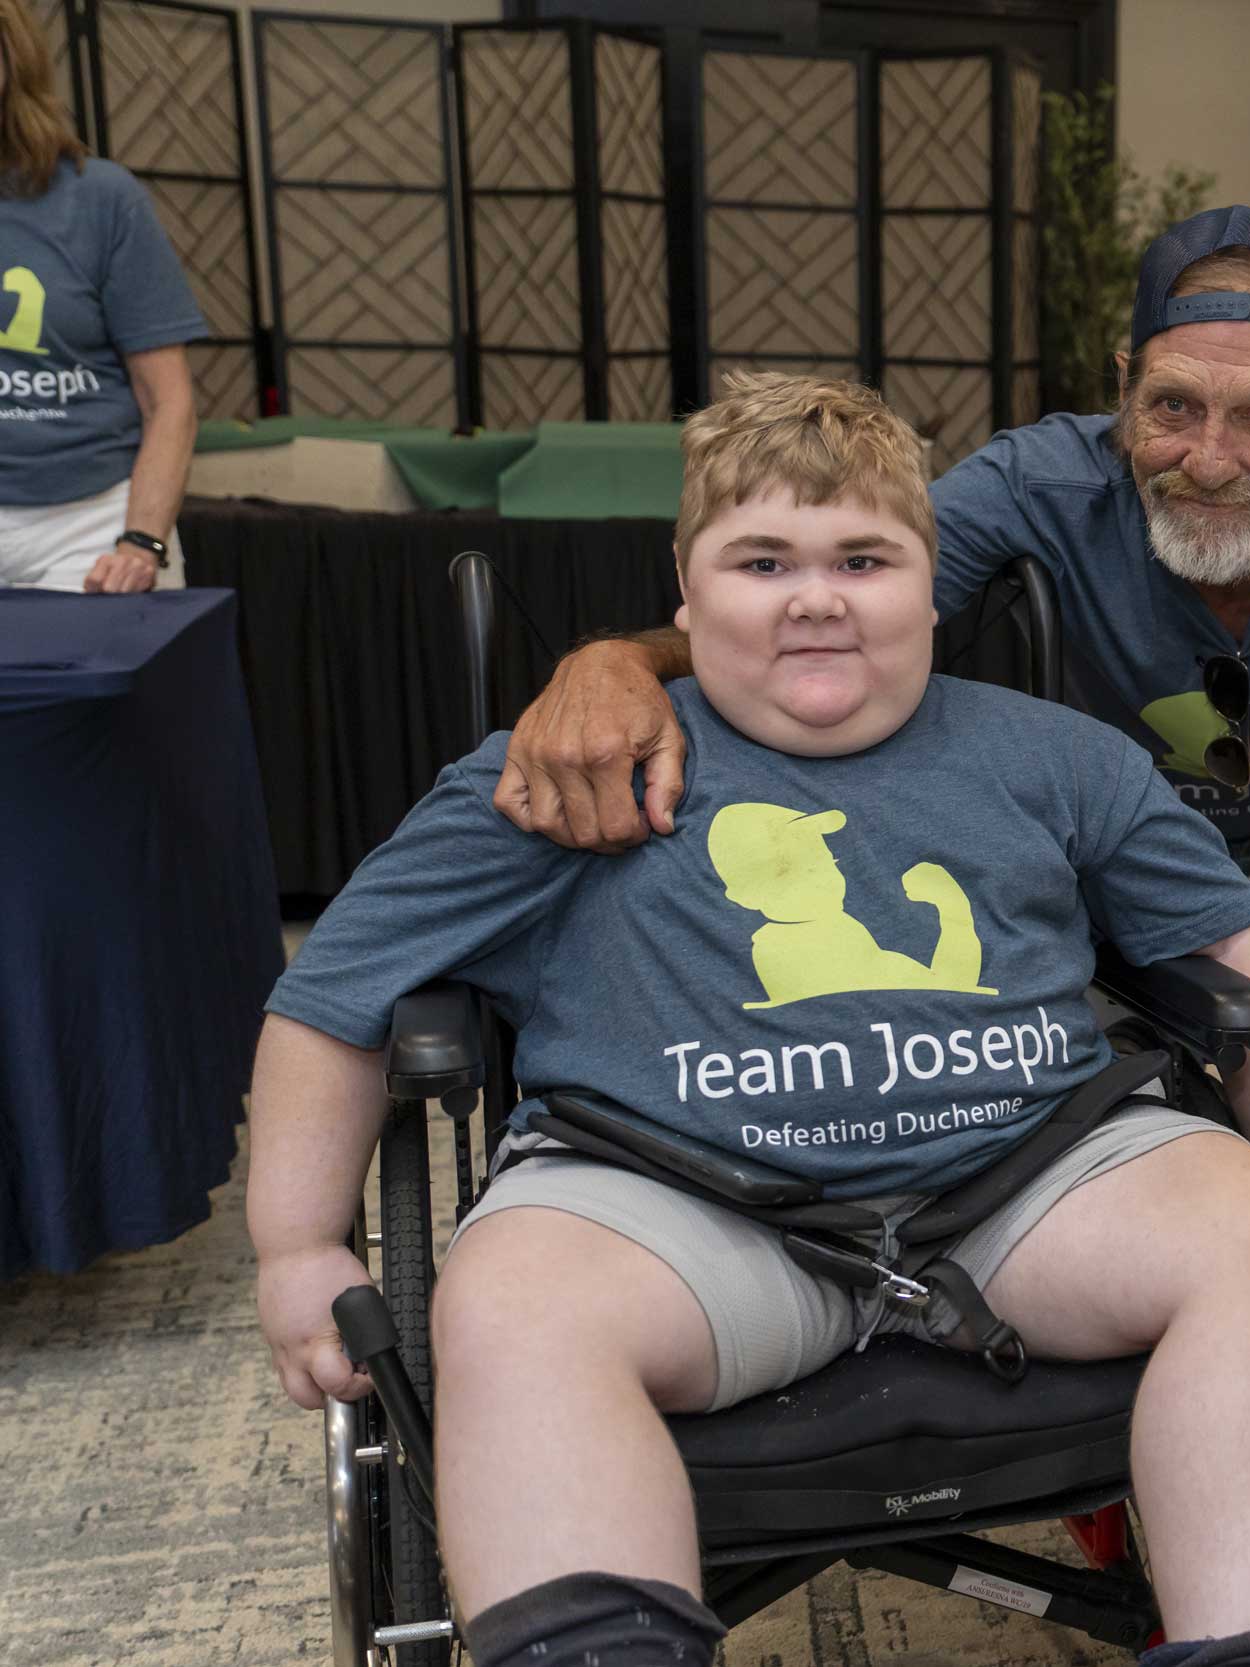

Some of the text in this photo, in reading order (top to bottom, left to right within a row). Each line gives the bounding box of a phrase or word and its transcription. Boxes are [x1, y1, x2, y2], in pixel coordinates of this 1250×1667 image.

[664, 1006, 1070, 1102] Team Joseph
[741, 1096, 1023, 1148] Defeating Duchenne
[911, 1487, 961, 1504] Mobility
